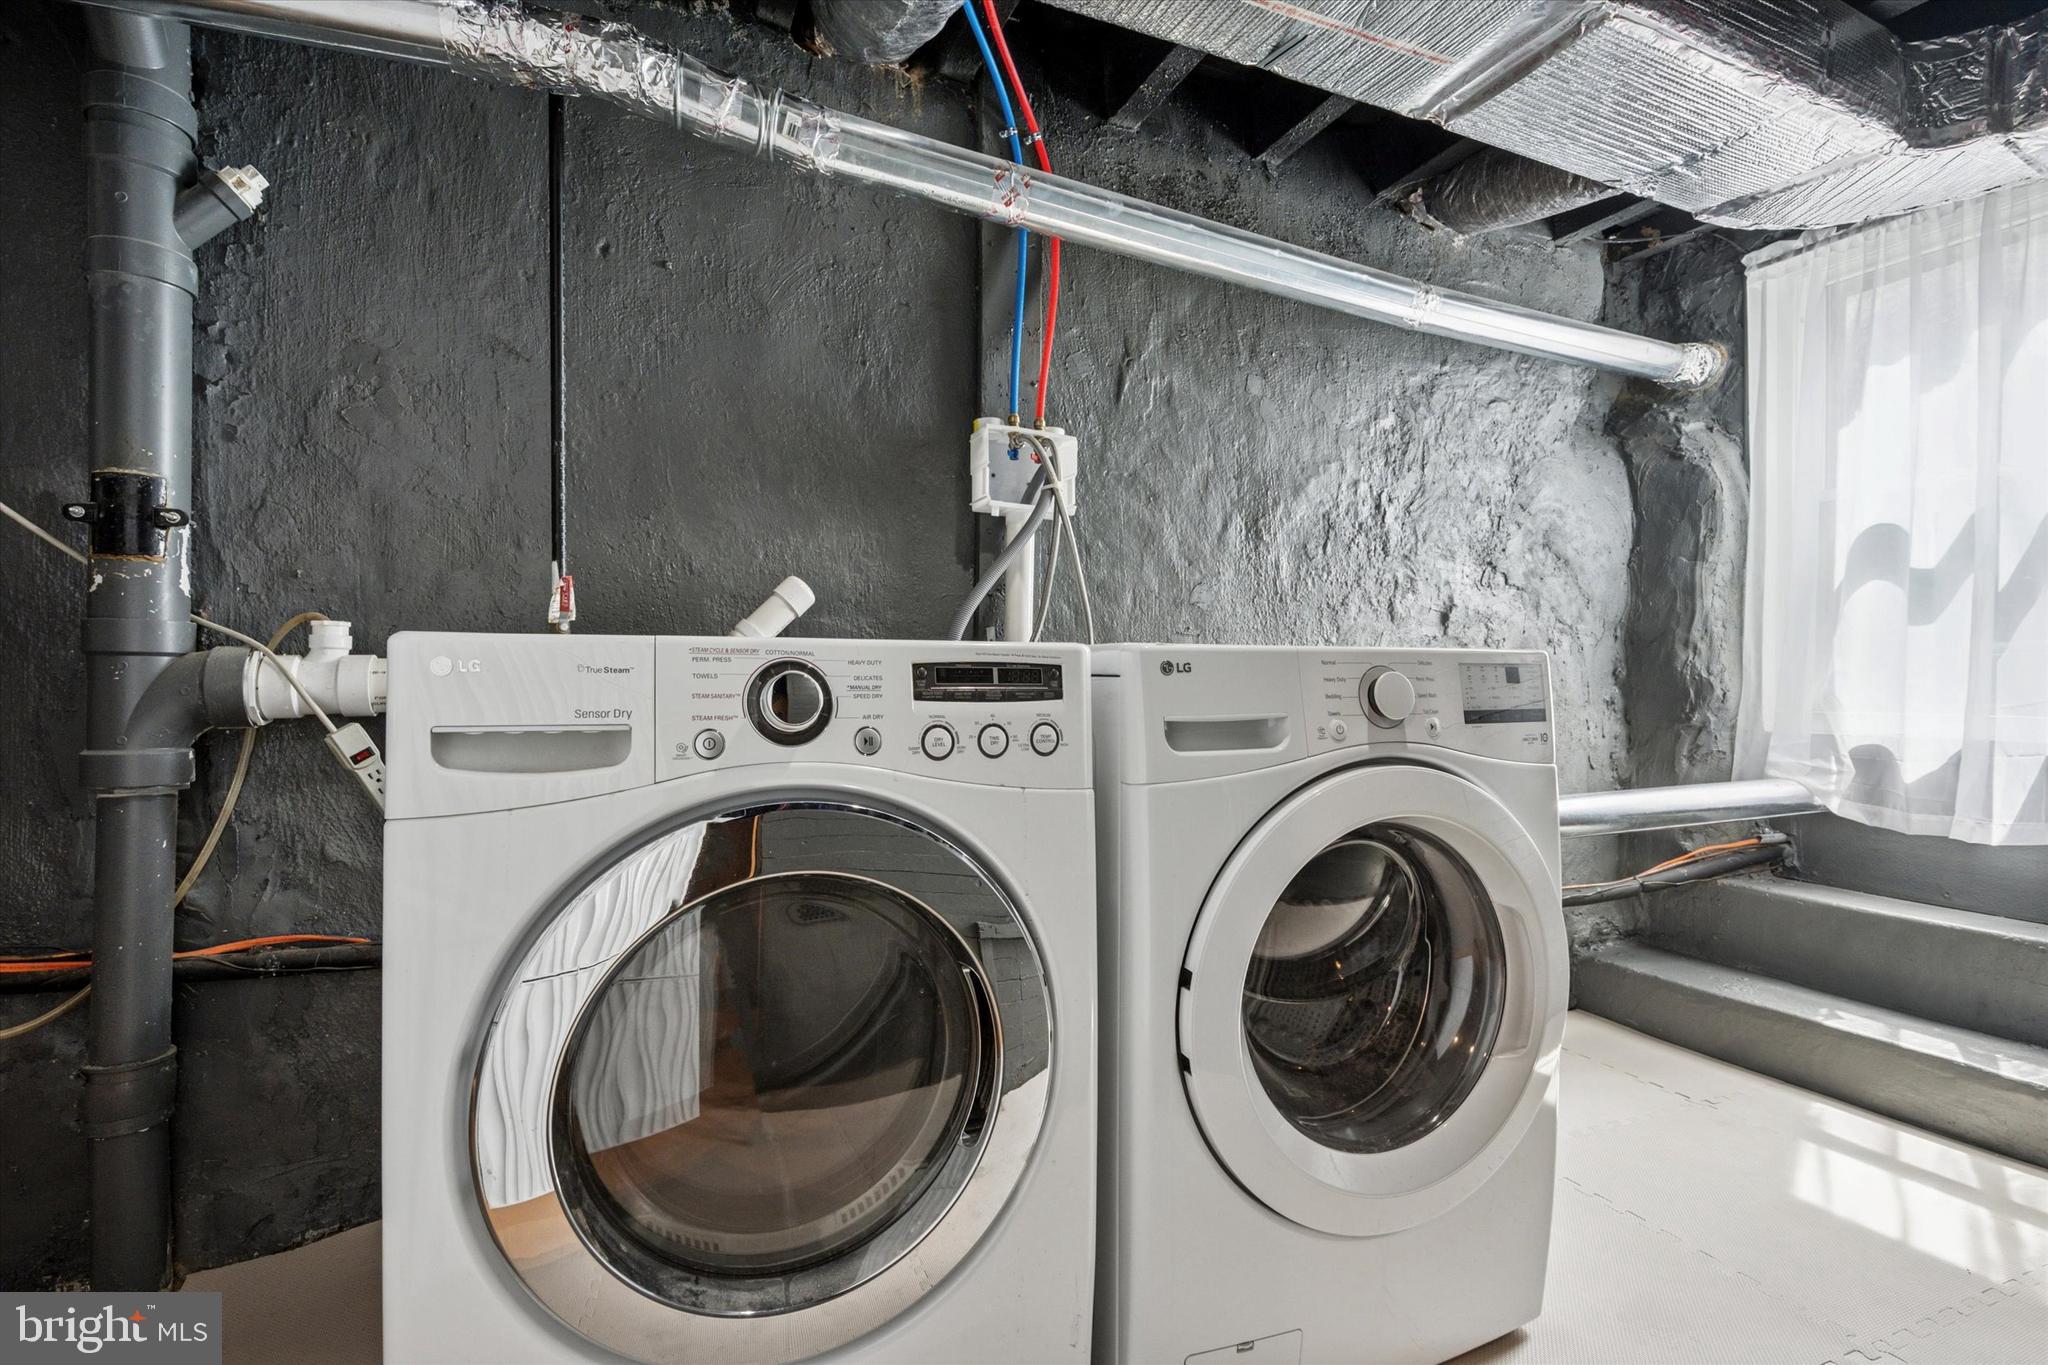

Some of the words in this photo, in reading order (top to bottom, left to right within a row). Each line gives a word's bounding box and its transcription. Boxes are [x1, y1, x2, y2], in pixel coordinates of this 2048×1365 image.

[457, 660, 481, 673] LG
[1177, 662, 1192, 673] LG
[574, 709, 611, 719] Sensor
[613, 708, 633, 720] Dry
